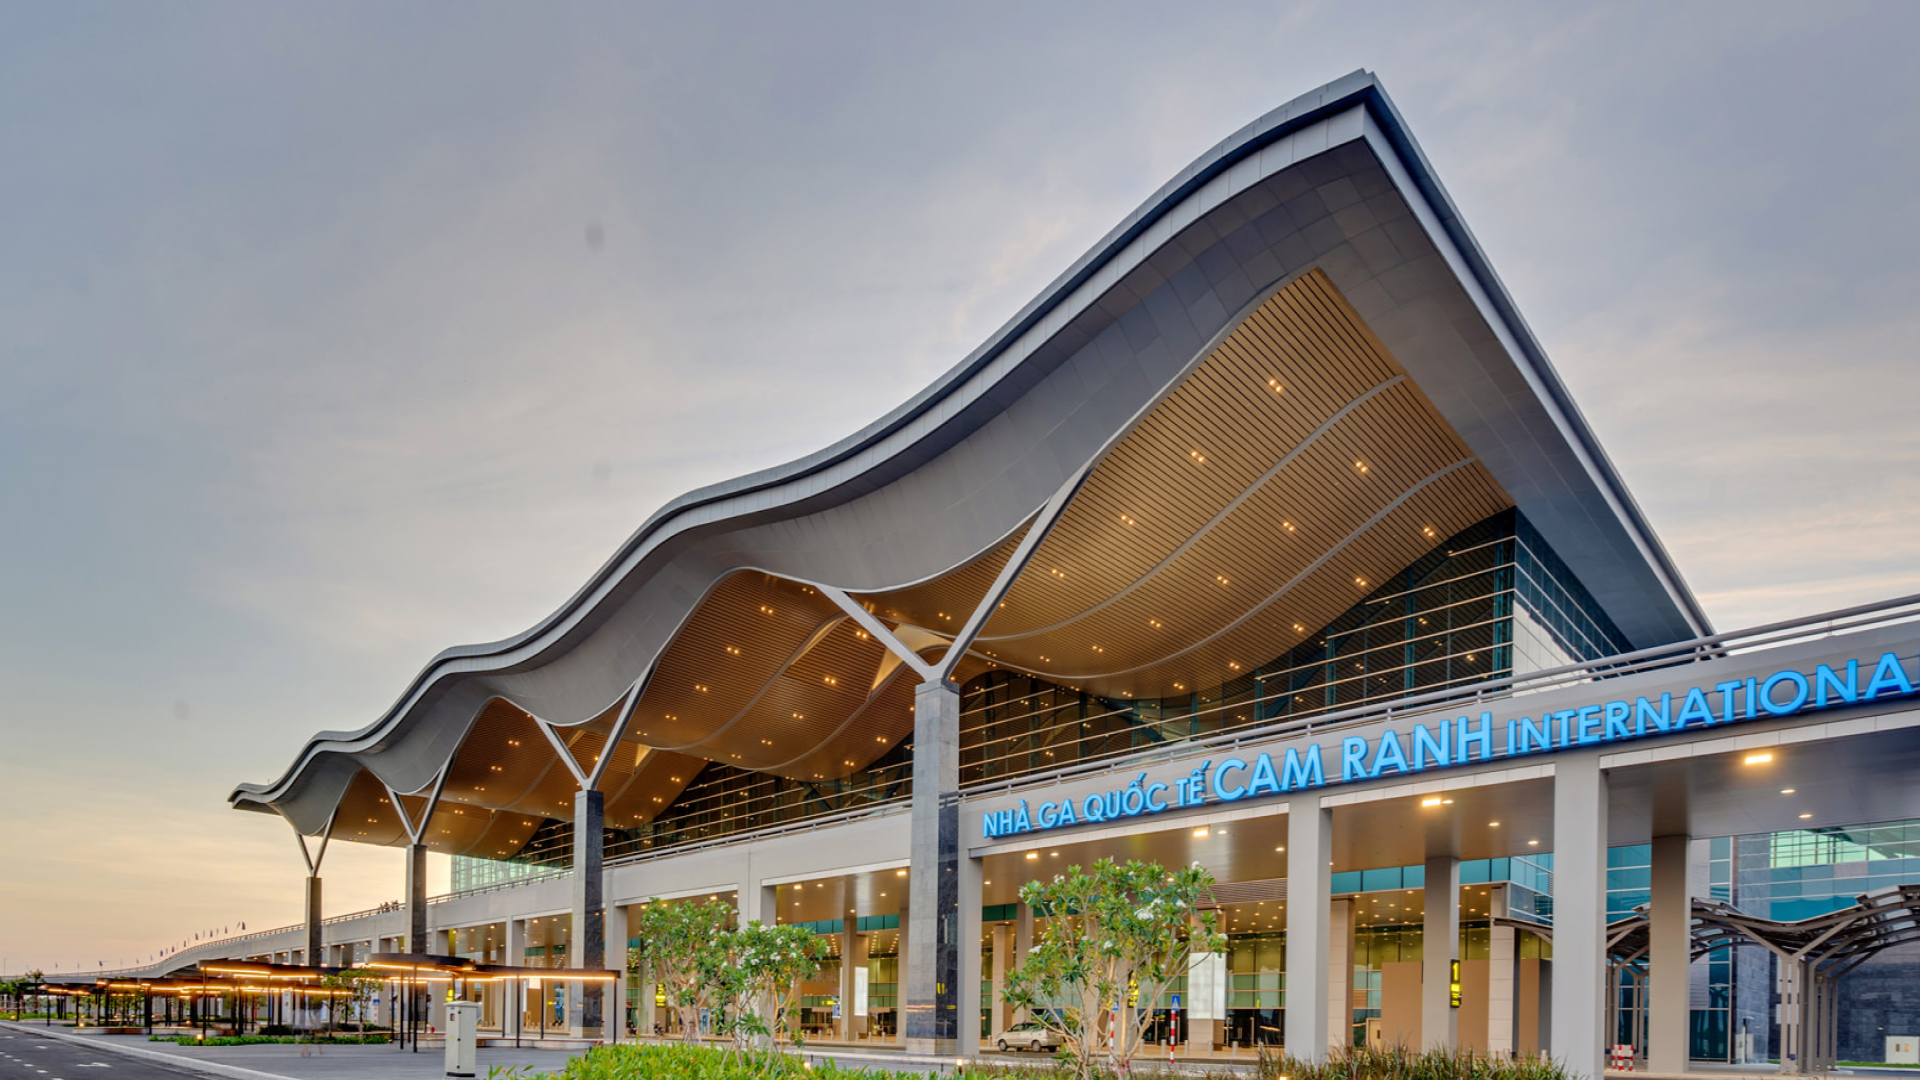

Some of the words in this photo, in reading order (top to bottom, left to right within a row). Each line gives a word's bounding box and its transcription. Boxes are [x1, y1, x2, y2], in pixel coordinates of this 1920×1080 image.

[983, 799, 1033, 838] NHÀ
[1037, 798, 1078, 829] GA
[1082, 772, 1169, 823] QUỐC
[1174, 759, 1211, 806] TẾ
[1213, 743, 1326, 801] CAM
[1341, 711, 1493, 783] RANH
[1506, 650, 1919, 756] INTERNATIONA
